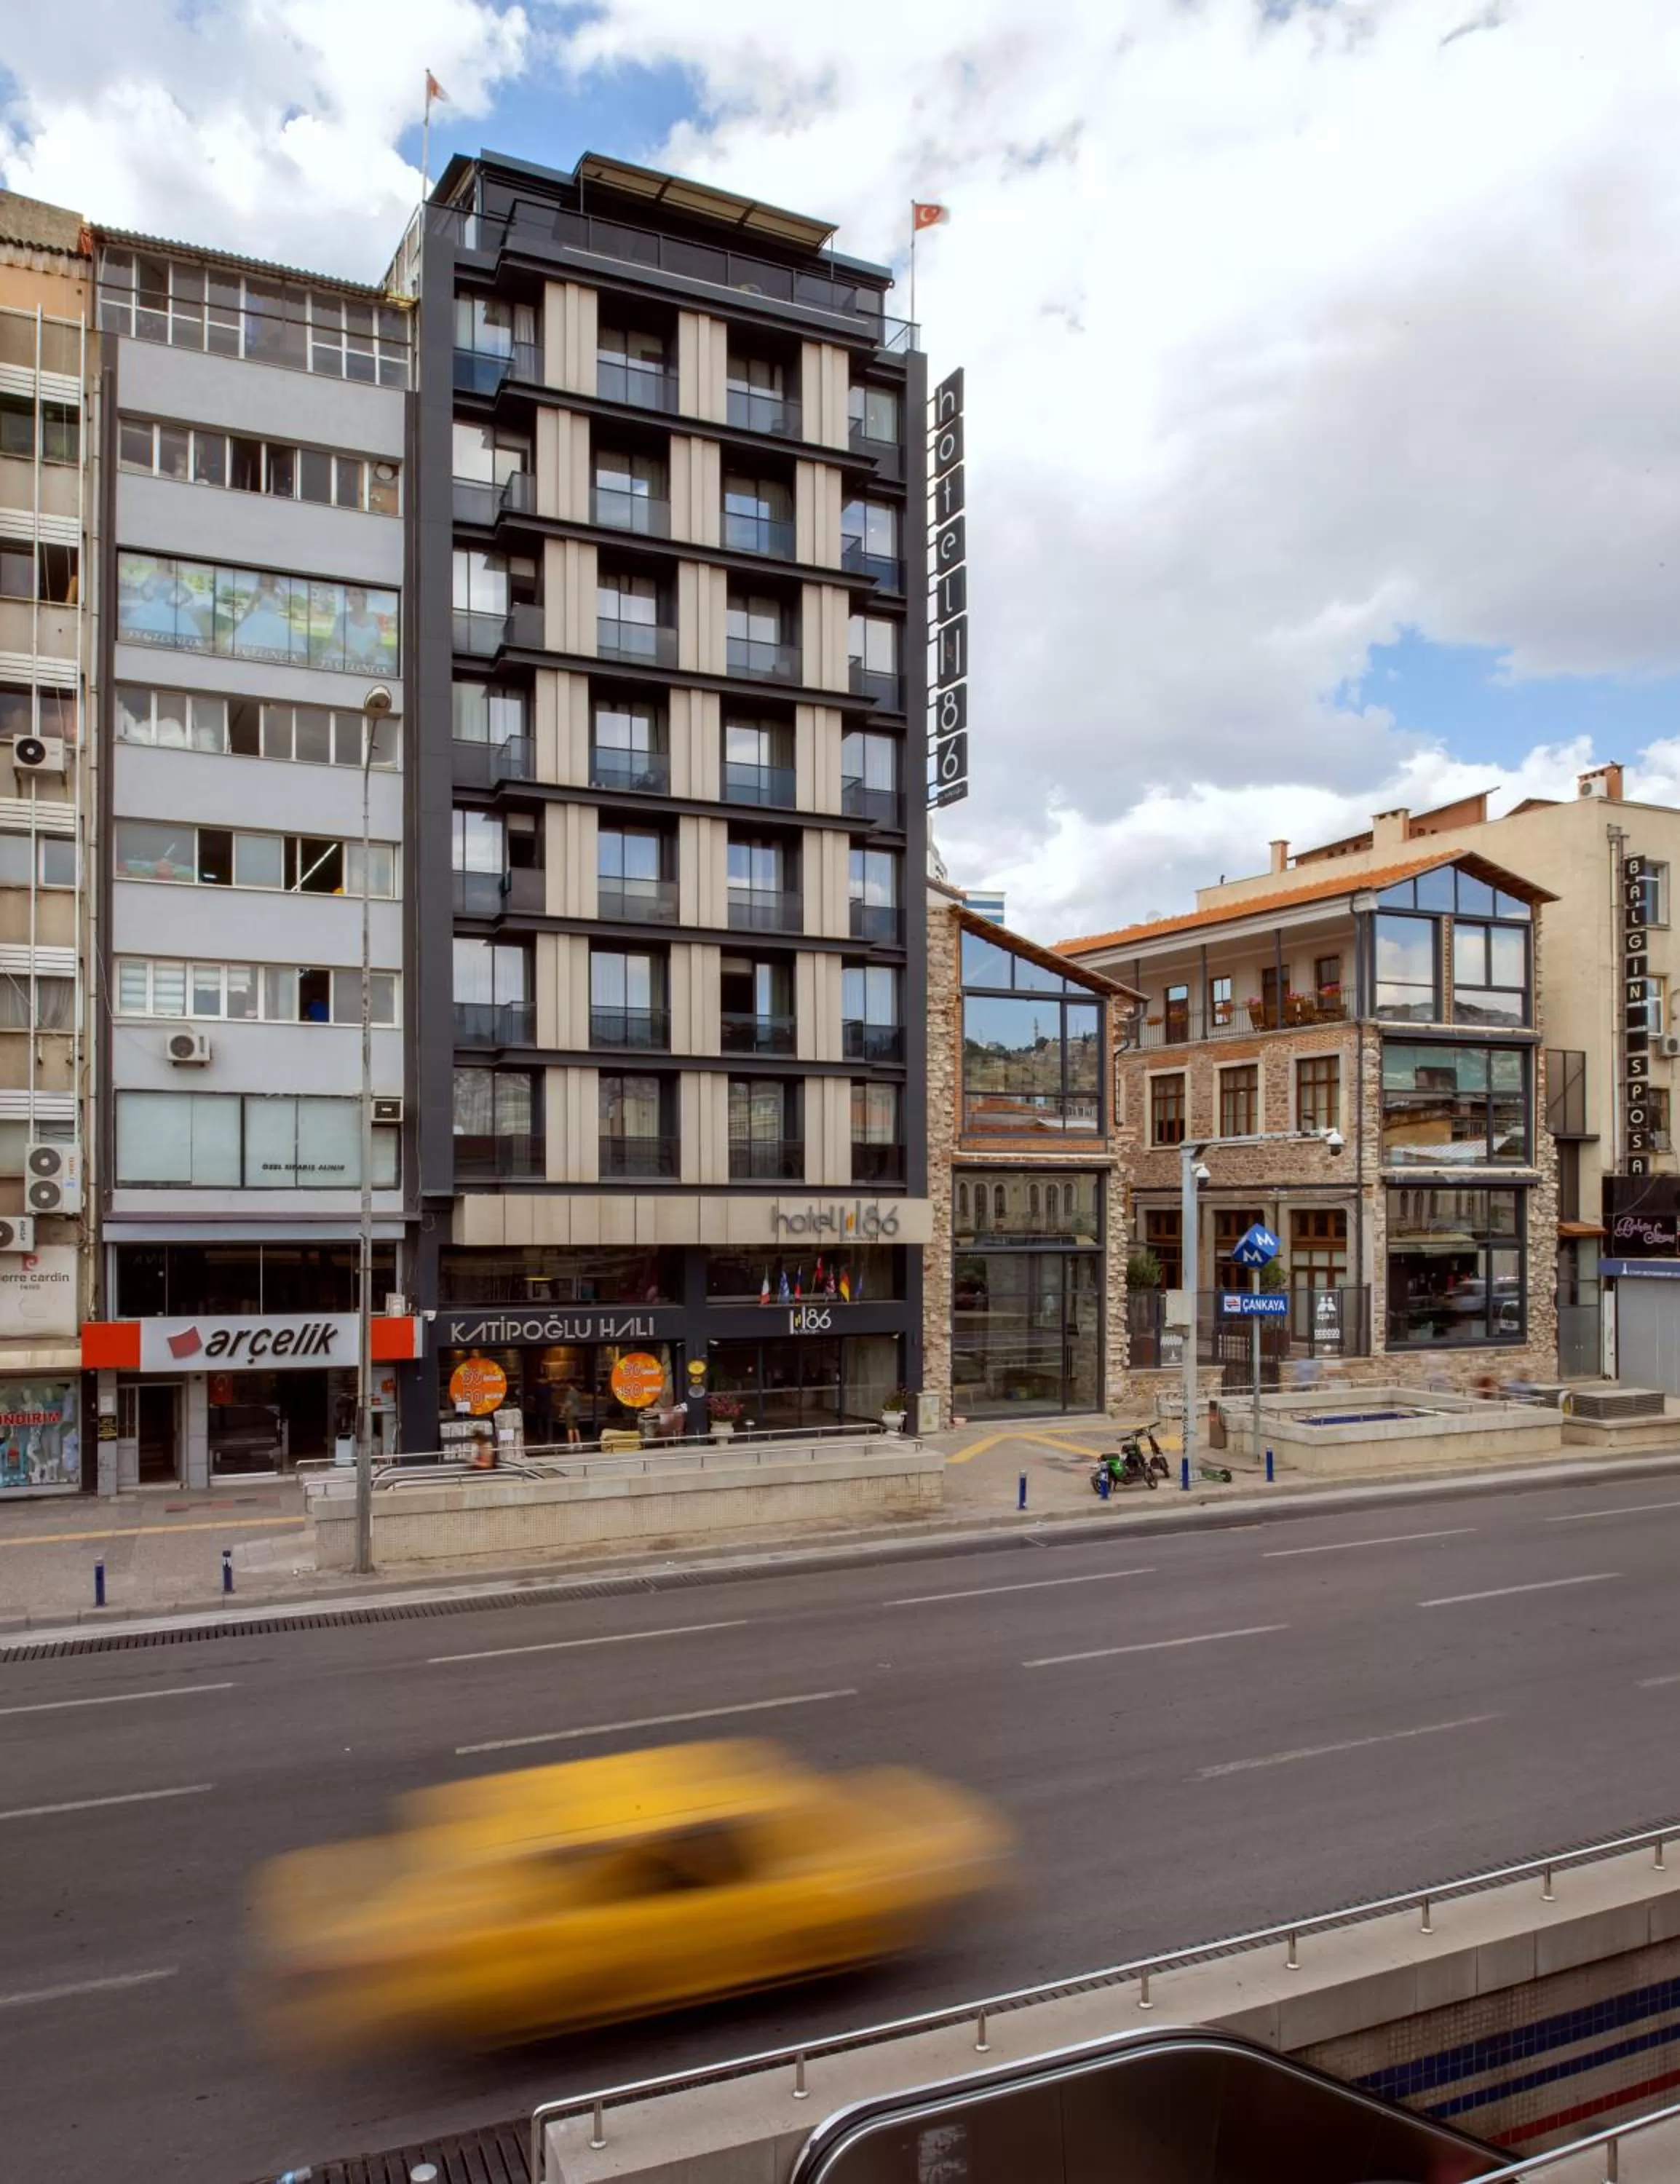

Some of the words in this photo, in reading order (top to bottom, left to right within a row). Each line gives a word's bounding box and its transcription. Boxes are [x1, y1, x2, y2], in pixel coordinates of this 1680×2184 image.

[938, 387, 956, 614] hotel
[1630, 1059, 1644, 1174] SPOSA
[771, 1204, 836, 1234] hotel
[1256, 1232, 1275, 1246] M
[1243, 1249, 1263, 1262] M
[0, 1273, 27, 1283] erre
[30, 1272, 70, 1282] cardin
[1243, 1298, 1285, 1313] ÇANKAYA
[450, 1314, 593, 1343] KATİPOĞLU
[599, 1317, 655, 1338] HALI
[205, 1322, 338, 1365] arçelik
